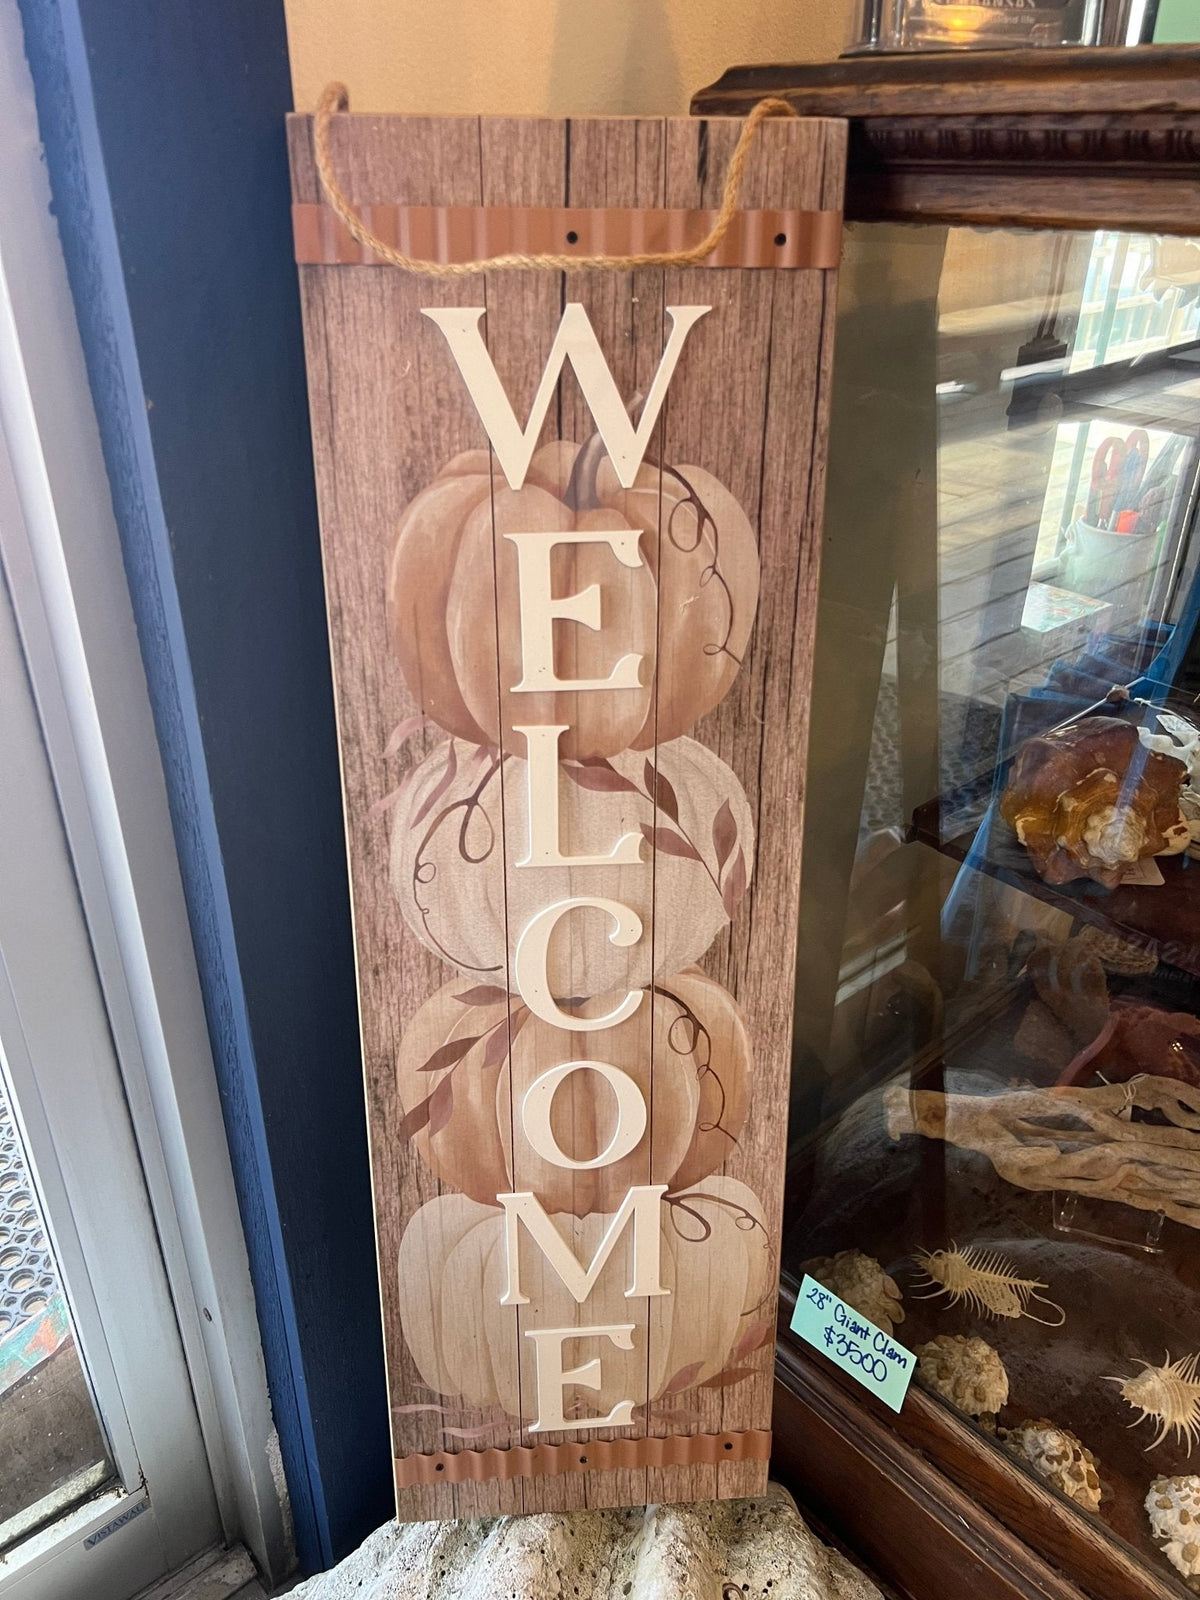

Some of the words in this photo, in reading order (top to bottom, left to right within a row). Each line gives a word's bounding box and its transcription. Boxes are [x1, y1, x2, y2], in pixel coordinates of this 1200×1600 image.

[421, 303, 713, 1433] WELCOME
[834, 1303, 871, 1340] Giant
[873, 1331, 908, 1369] Clam
[87, 1502, 147, 1546] VISTAWALL
